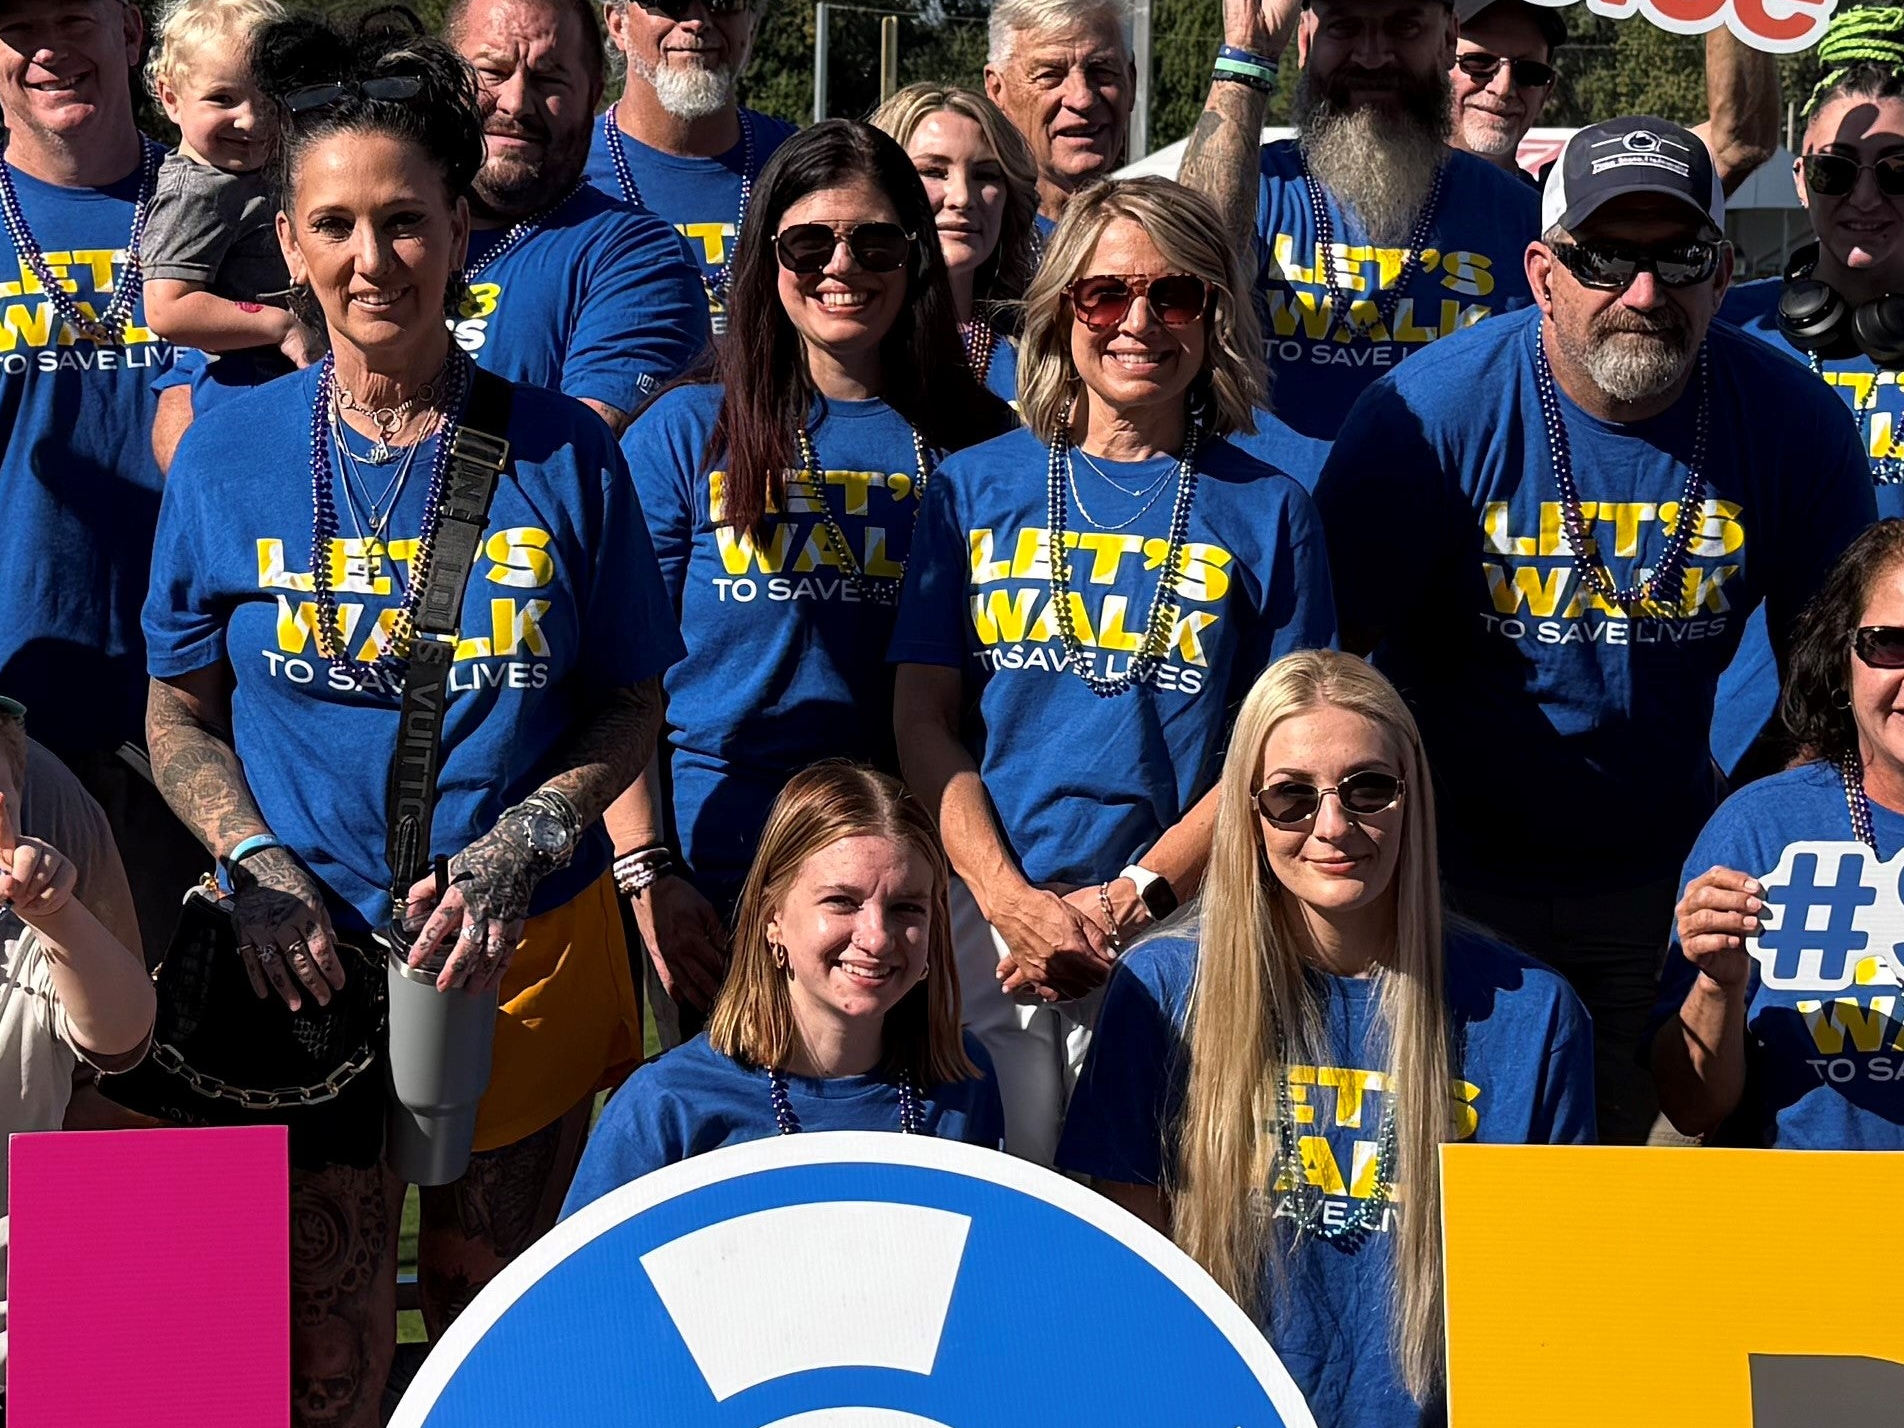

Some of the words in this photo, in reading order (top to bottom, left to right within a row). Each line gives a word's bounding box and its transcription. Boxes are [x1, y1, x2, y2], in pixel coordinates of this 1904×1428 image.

[1269, 232, 1494, 294] LET'S
[37, 350, 117, 373] SAVE
[1263, 340, 1301, 362] TO
[1311, 344, 1391, 366] SAVE
[1483, 500, 1744, 558] LET'S
[715, 527, 907, 577] WAL
[969, 528, 1233, 602] LET'S
[713, 578, 757, 602] TO
[768, 578, 860, 603] SAVE
[1482, 563, 1741, 618] WALK
[971, 589, 1218, 668] WALK
[1479, 613, 1526, 639] TO
[1536, 622, 1628, 646] SAVE
[1637, 617, 1728, 642] LIVES
[262, 651, 314, 685] TO
[448, 663, 548, 690] LIVES
[1002, 645, 1095, 675] SAVE
[399, 681, 441, 822] VUITTO
[1805, 1056, 1855, 1083] TO
